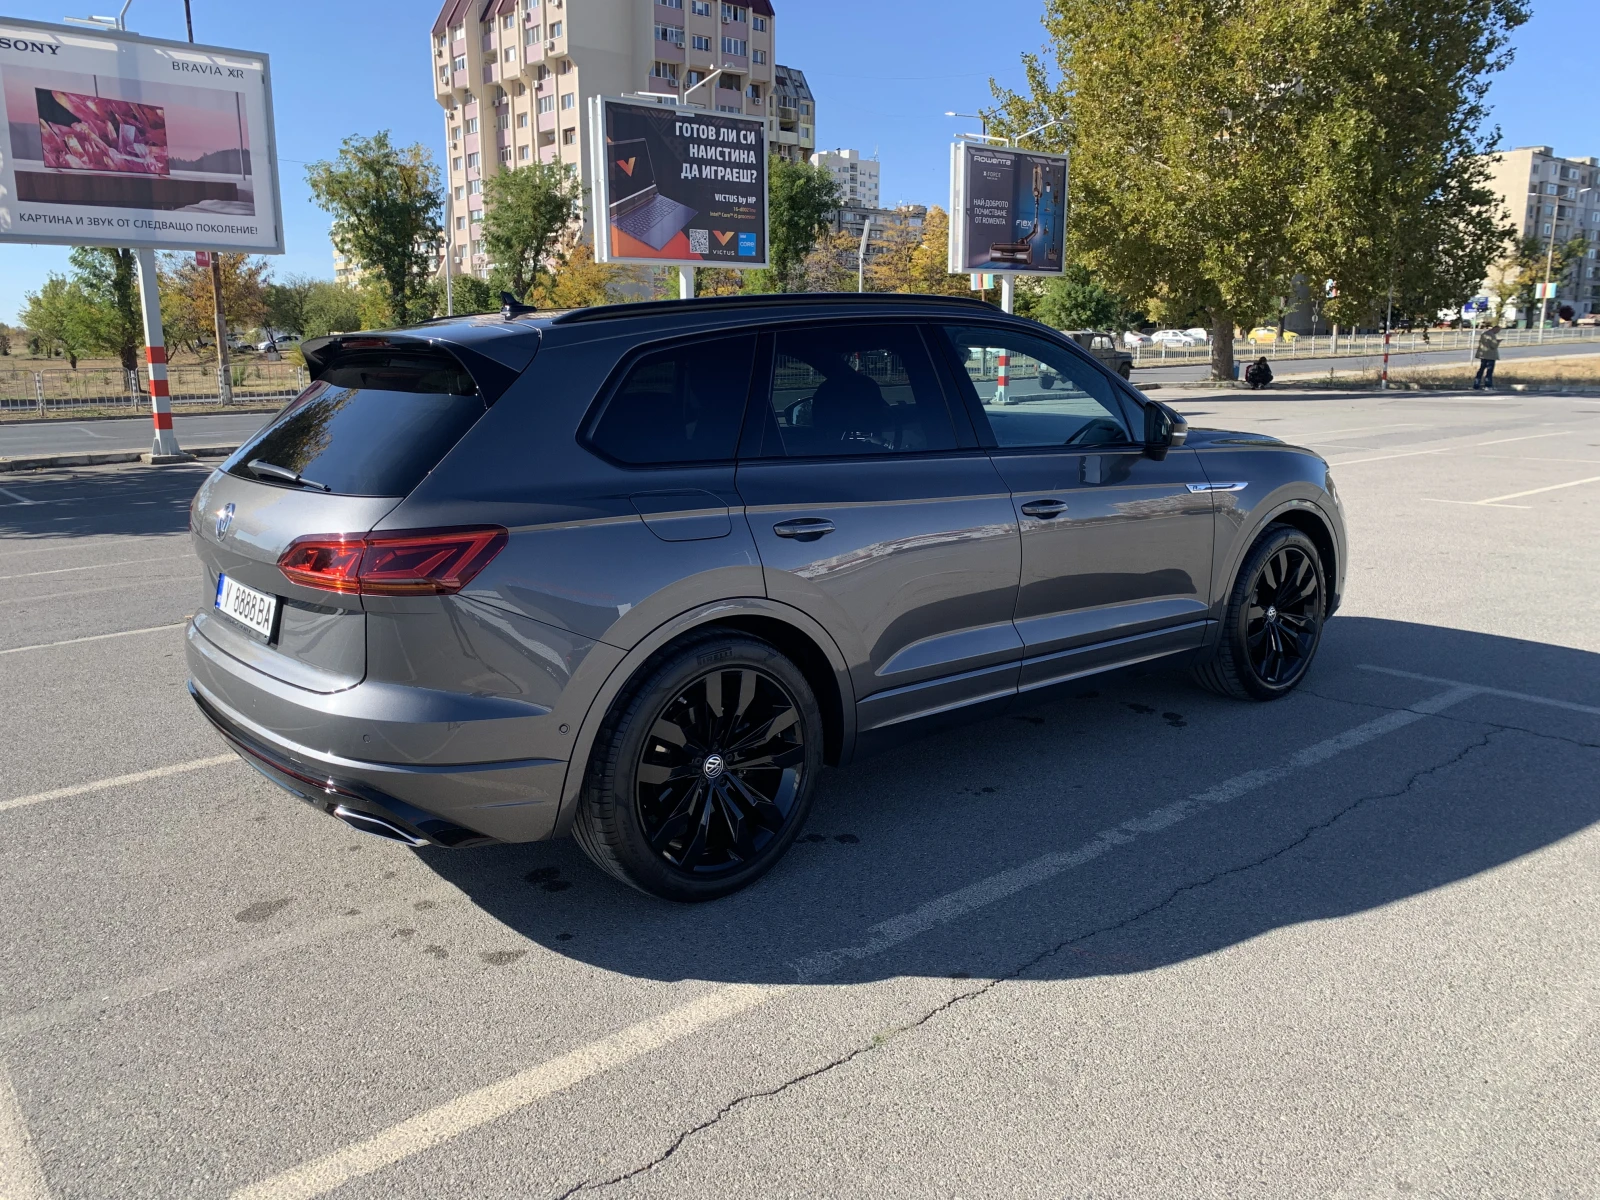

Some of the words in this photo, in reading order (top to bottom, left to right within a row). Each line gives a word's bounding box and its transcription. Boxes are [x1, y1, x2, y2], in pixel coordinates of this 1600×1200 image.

[0, 38, 61, 55] SONY
[172, 61, 223, 76] BRAVIA
[227, 68, 244, 79] XR
[675, 121, 716, 140] ГОТОВ
[719, 127, 737, 143] ЛИ
[740, 130, 756, 145] СИ
[689, 143, 757, 165] НАИСТИНА
[973, 155, 1012, 166] Rowenta
[680, 162, 700, 180] ДА
[701, 164, 758, 184] ИГРАЕШ?
[714, 193, 738, 203] VICTUS
[738, 195, 747, 205] by
[747, 196, 757, 205] HP
[973, 198, 1009, 208] НАЙ-ДОБРОТО
[974, 207, 1008, 217] ПОЧИСТВАНЕ
[974, 216, 982, 224] ОТ
[19, 212, 73, 226] КАРТИНА
[75, 216, 84, 226] И
[86, 216, 115, 228] ЗВУК
[116, 218, 131, 228] ОТ
[133, 219, 194, 233] СЛЕДВАЩО
[195, 222, 259, 236] ПОКОЛЕНИЕ!
